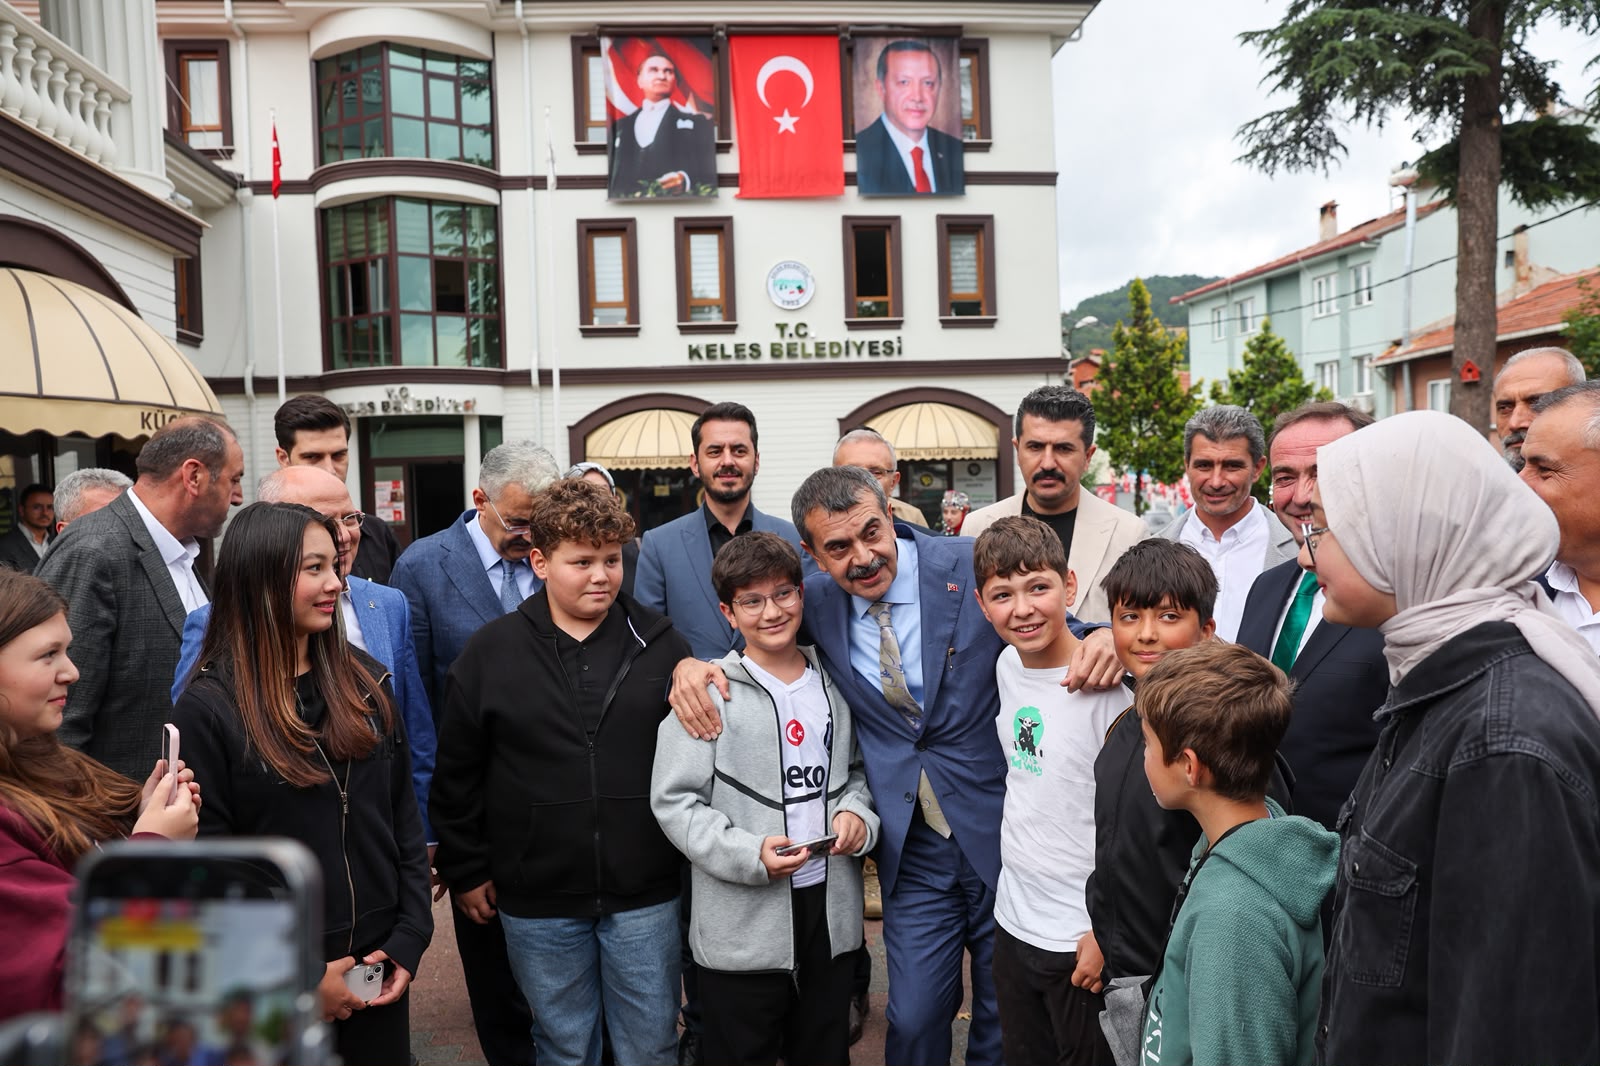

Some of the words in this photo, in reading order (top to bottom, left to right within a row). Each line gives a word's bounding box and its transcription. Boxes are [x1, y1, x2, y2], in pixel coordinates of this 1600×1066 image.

[688, 343, 762, 361] KELES
[770, 336, 903, 359] BELEDİYESİ
[783, 764, 826, 789] eko
